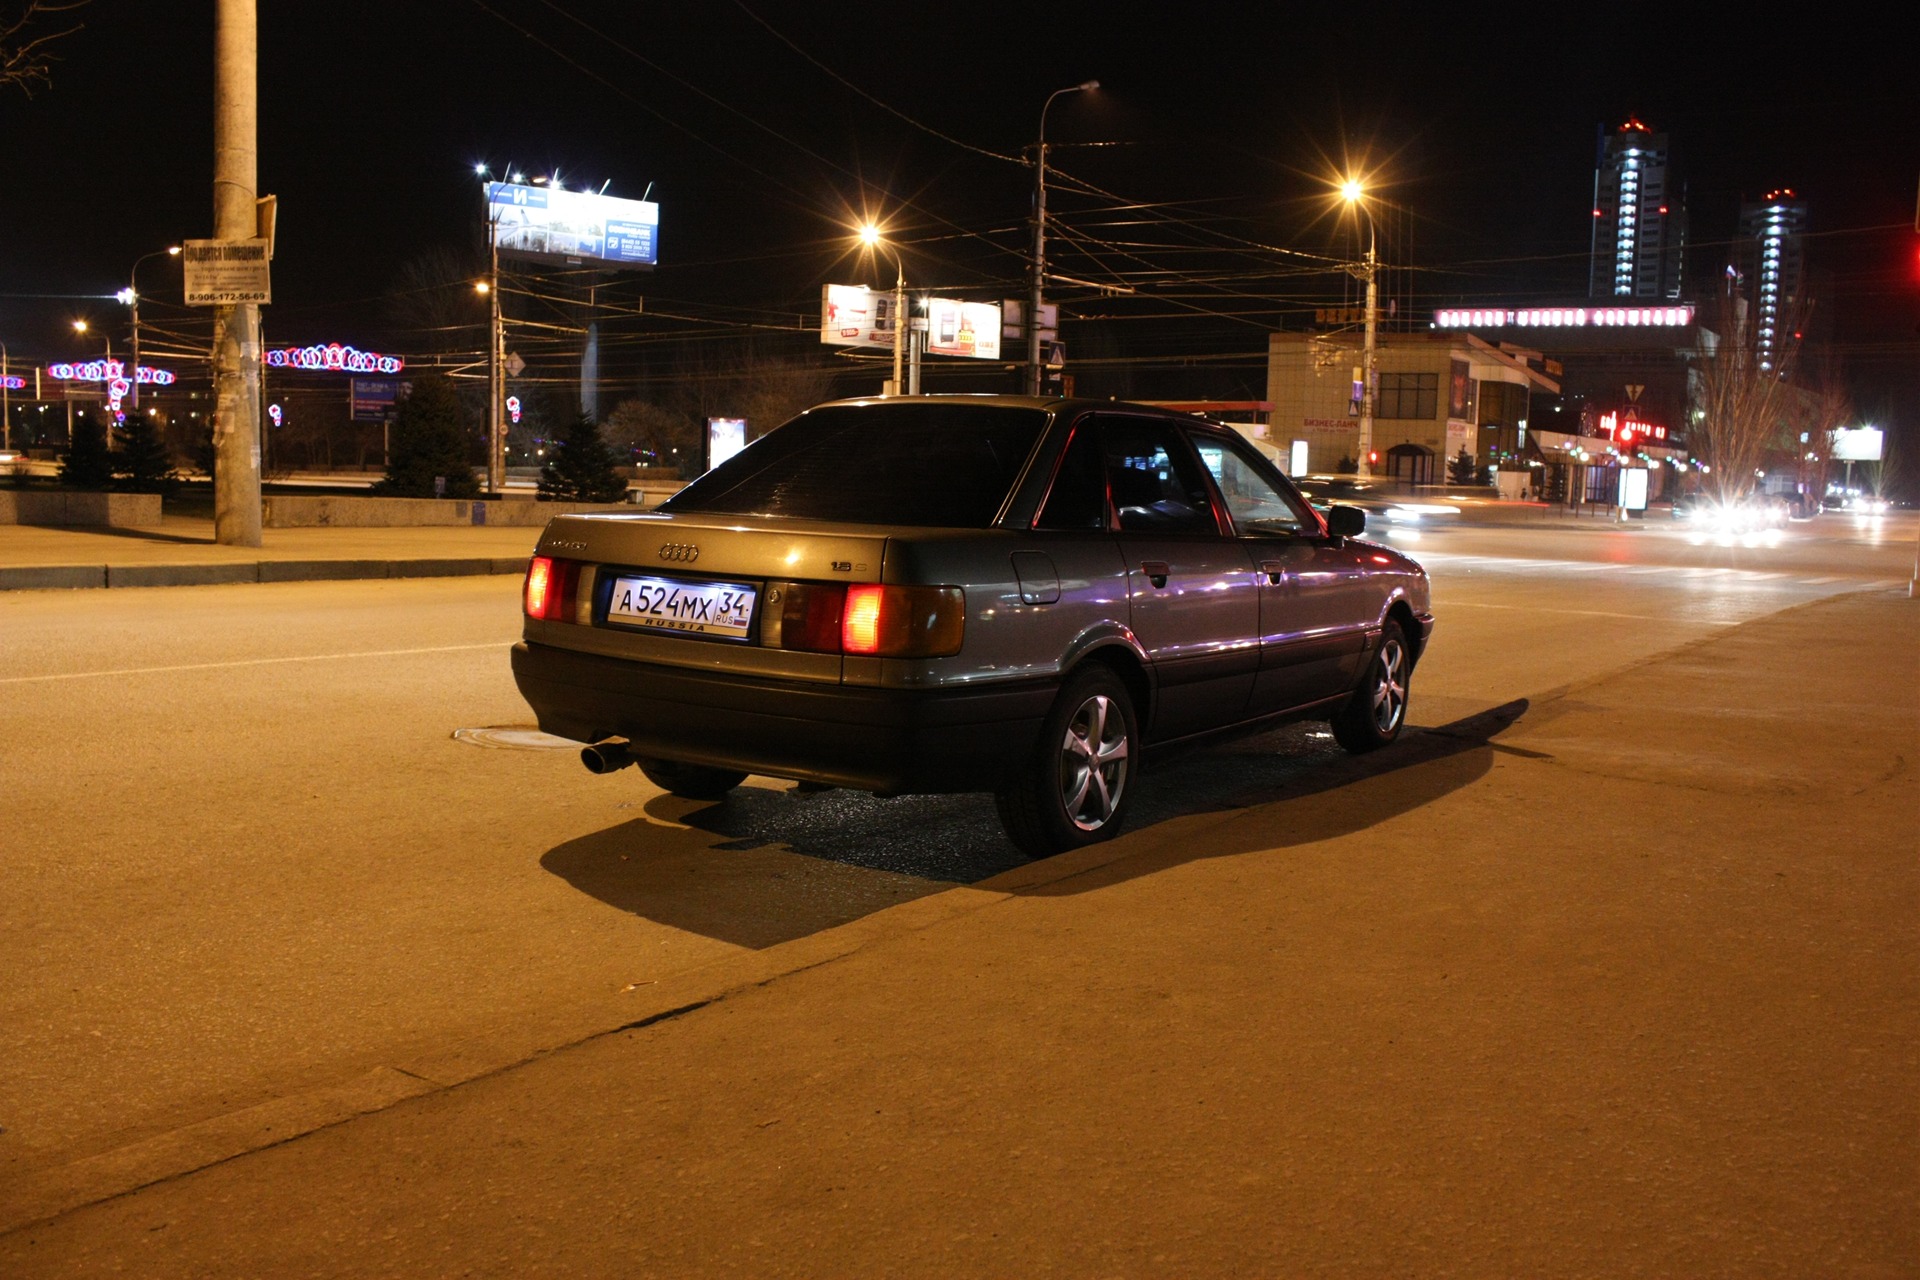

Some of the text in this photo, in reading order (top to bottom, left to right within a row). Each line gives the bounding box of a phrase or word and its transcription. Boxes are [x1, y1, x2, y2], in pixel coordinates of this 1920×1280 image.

[189, 292, 265, 301] 8-906-172-56-69
[719, 592, 746, 615] 34
[645, 618, 705, 632] RUSSIA
[715, 614, 734, 625] RUS
